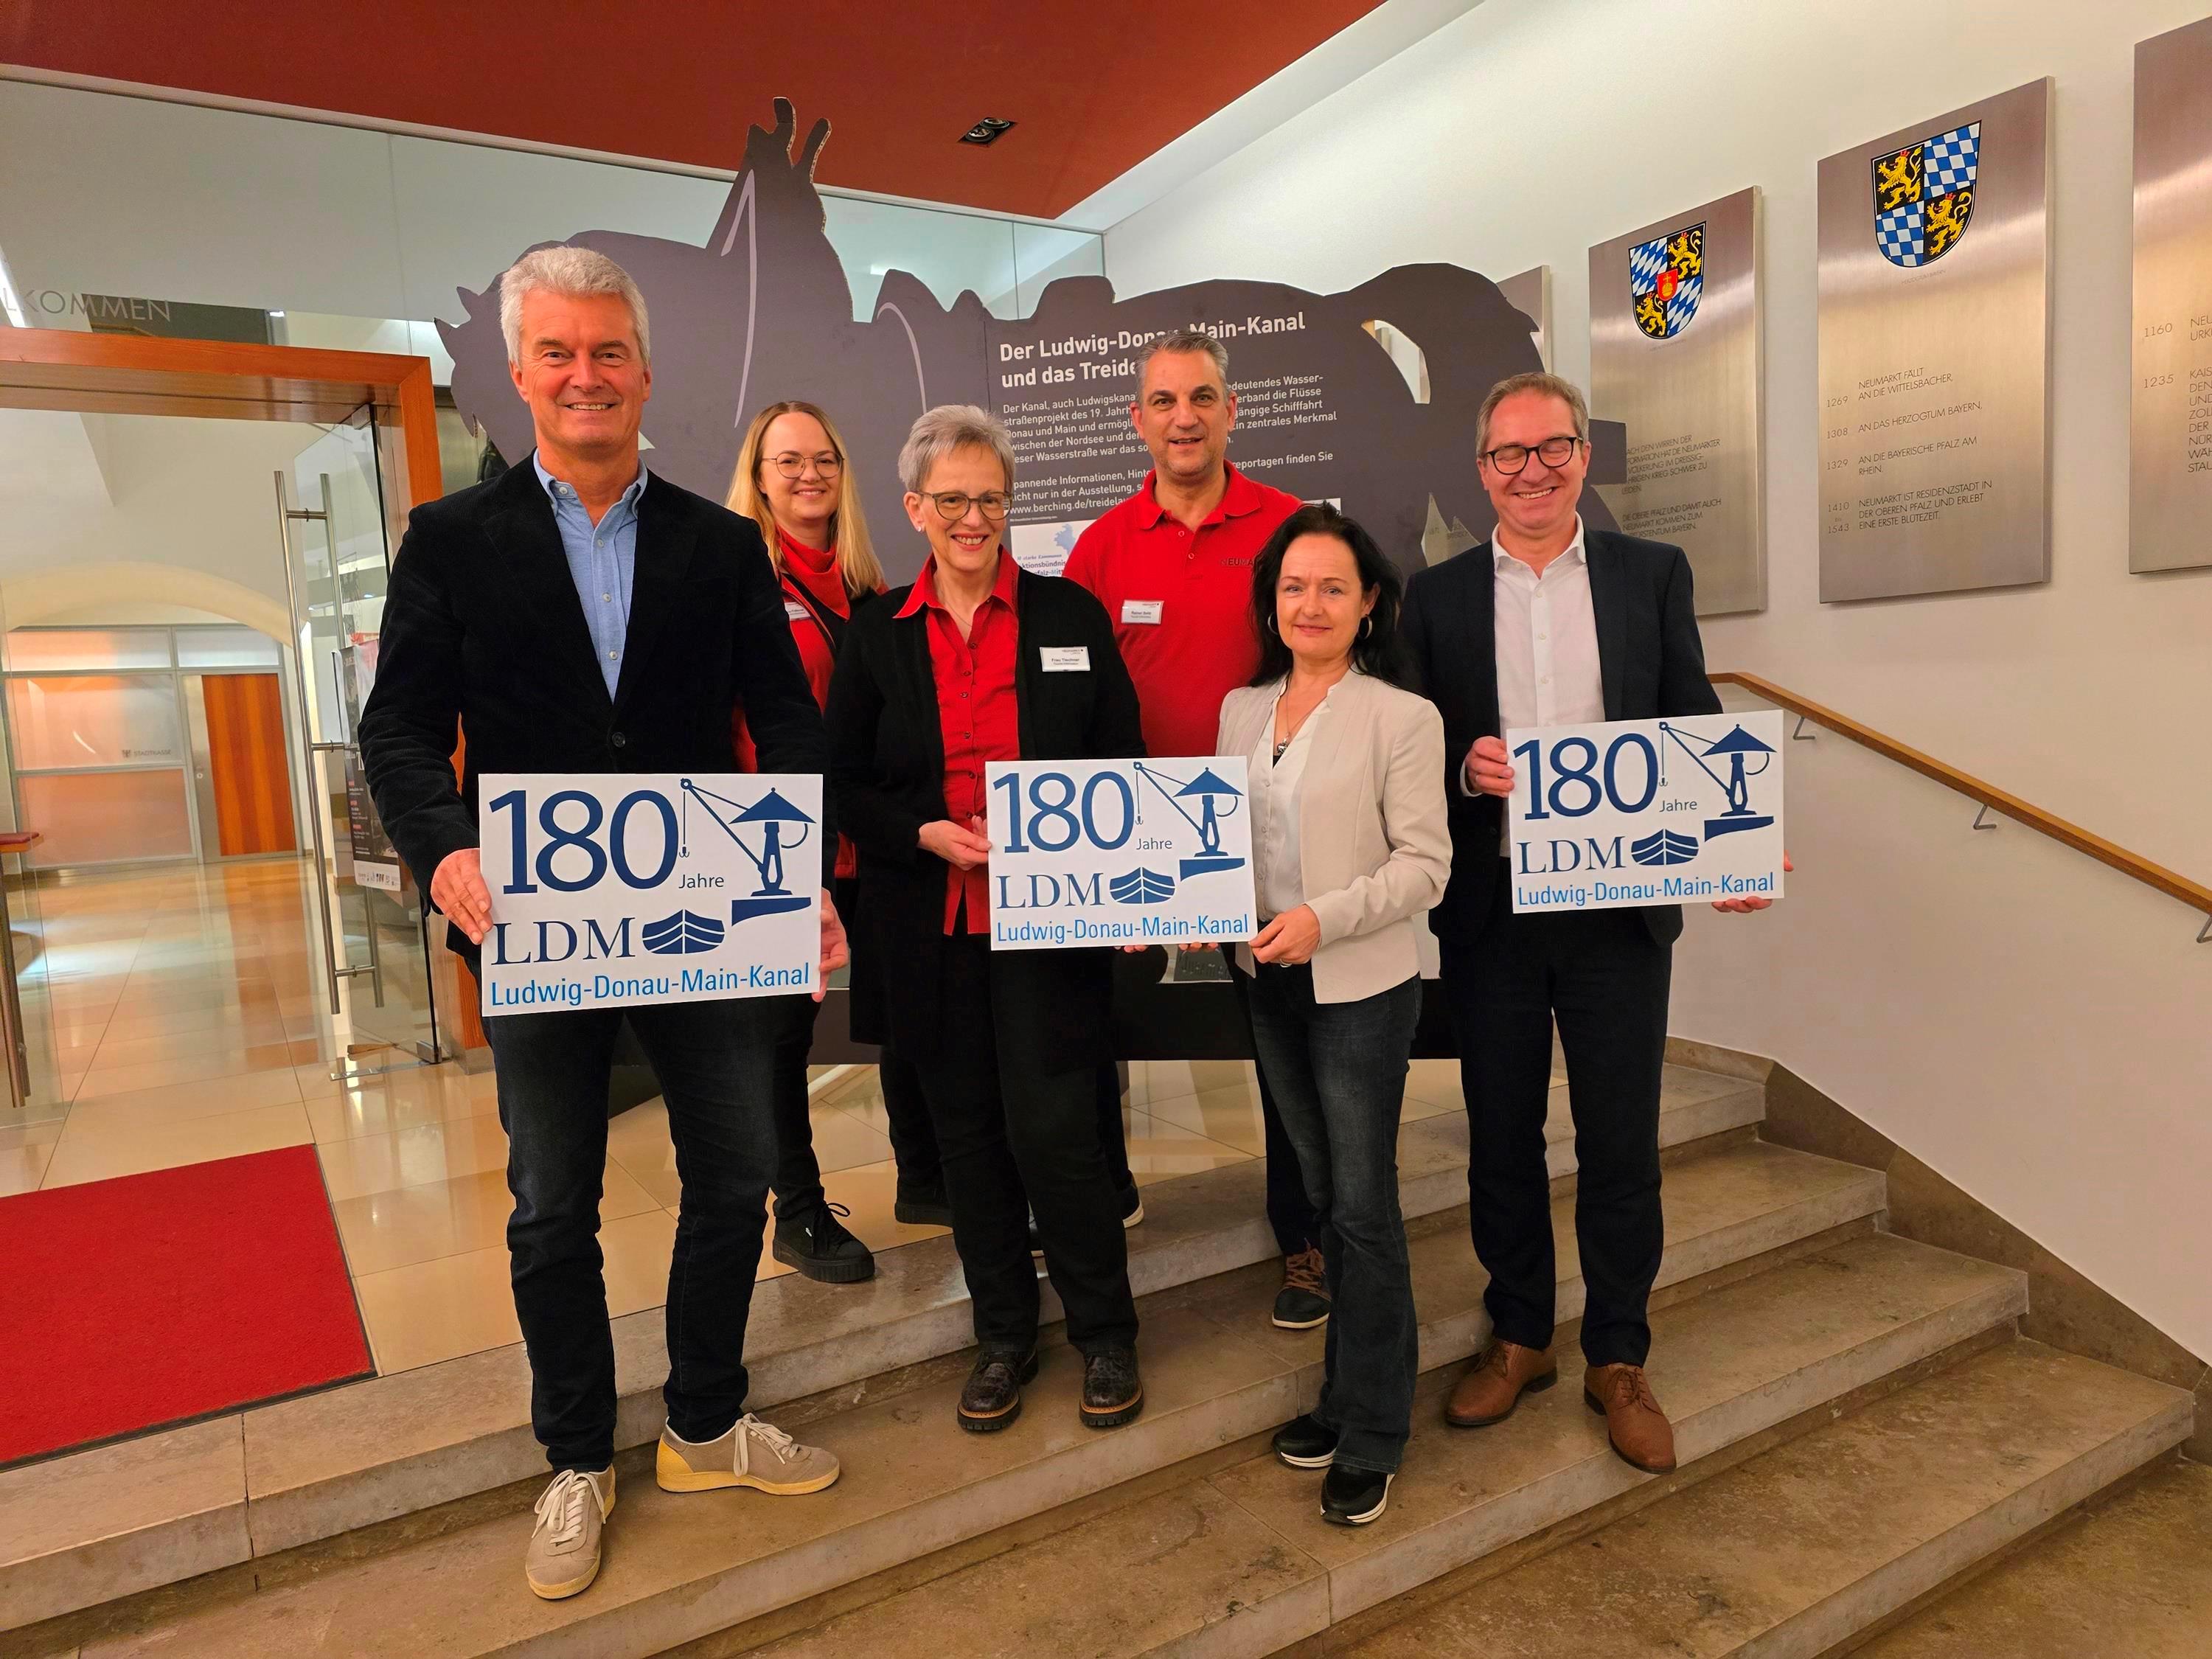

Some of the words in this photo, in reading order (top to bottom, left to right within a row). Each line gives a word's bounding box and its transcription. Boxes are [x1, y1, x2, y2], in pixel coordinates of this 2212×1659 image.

[3, 288, 170, 321] LKOMMEN
[2144, 323, 2172, 337] 1160
[2190, 329, 2212, 341] URK
[1000, 344, 1034, 361] Der
[1002, 368, 1036, 388] und
[1042, 366, 1075, 383] das
[1079, 358, 1135, 380] Treide
[1859, 372, 1902, 389] NEUMARKT
[1905, 368, 1923, 379] FÄLLT
[2143, 374, 2174, 389] 1235
[1004, 404, 1019, 414] Der
[1022, 401, 1050, 411] Kanal,
[1052, 398, 1074, 408] auch
[1077, 392, 1137, 406] Ludwigskana
[1227, 378, 1281, 391] edeutendes
[1283, 375, 1324, 385] Wasser-
[1827, 396, 1848, 407] 1269
[1858, 392, 1871, 400] AN
[1874, 389, 1885, 397] DIE
[1004, 412, 1069, 426] straßenprojekt
[1071, 410, 1088, 420] des
[1106, 407, 1131, 417] Jahrh
[1238, 392, 1270, 403] erband
[1273, 391, 1287, 400] die
[1290, 389, 1321, 398] Flüsse
[1858, 424, 1871, 433] AN
[1874, 420, 1890, 430] DAS
[1892, 408, 1945, 426] HERZOGTUM
[1948, 401, 1983, 414] BAYERN,
[1036, 427, 1052, 437] und
[1055, 424, 1077, 434] Main
[1079, 422, 1096, 432] und
[1099, 419, 1133, 431] ermögli
[1273, 400, 1322, 413] Schifffahrt
[2189, 421, 2209, 432] DER
[1012, 439, 1046, 451] wischen
[1048, 439, 1064, 448] der
[1066, 436, 1104, 445] Nordsee
[1107, 433, 1123, 442] und
[1247, 417, 1291, 429] zentrales
[1294, 411, 1337, 424] Merkmal
[1827, 428, 1848, 439] 1308
[1015, 455, 1034, 463] eser
[1036, 448, 1097, 461] Wasserstraße
[1099, 447, 1117, 456] war
[1119, 445, 1135, 453] das
[1858, 456, 1871, 464] AN
[1874, 452, 1885, 462] DIE
[1888, 443, 1933, 459] BAYERISCHE
[1936, 439, 1959, 451] PFALZ
[1962, 437, 1977, 445] AM
[1014, 478, 1057, 490] pannende
[1060, 472, 1125, 484] Informationen,
[1232, 458, 1283, 470] reportagen
[1287, 454, 1315, 464] finden
[1318, 452, 1333, 460] Sie
[1827, 459, 1848, 470] 1329
[1012, 493, 1031, 501] icht
[1062, 488, 1077, 496] der
[1079, 484, 1135, 495] Ausstellung,
[1859, 494, 1902, 507] NEUMARKT
[1904, 492, 1913, 500] IST
[1916, 481, 1979, 499] RESIDENZSTADT
[1982, 481, 1992, 490] IN
[1010, 498, 1128, 513] www.berching.de/treidela
[1828, 502, 1849, 512] 1410
[1876, 504, 1907, 515] OBEREN
[1910, 501, 1931, 511] PFALZ
[1935, 498, 1954, 508] UND
[1958, 493, 1984, 504] ERLEBT
[1829, 524, 1849, 534] 1543
[1860, 521, 1876, 530] EINE
[1878, 517, 1899, 527] ERSTE
[1023, 560, 1066, 568] ktionsbündnis
[1513, 733, 1658, 820] 180
[993, 771, 1134, 853] 180
[1659, 800, 1697, 813] Jahre
[489, 790, 678, 894] 180
[1136, 838, 1172, 850] Jahre
[1516, 836, 1627, 874] LDM
[678, 874, 724, 888] Jahre
[996, 872, 1105, 909] LDM
[1518, 872, 1773, 906] Ludwig-Donau-Main-Kanal
[998, 914, 1248, 945] Ludwig-Donau-Main-Kanal
[492, 917, 636, 965] LDM
[492, 961, 809, 1006] Ludwig-Donau-Main-Kanal
